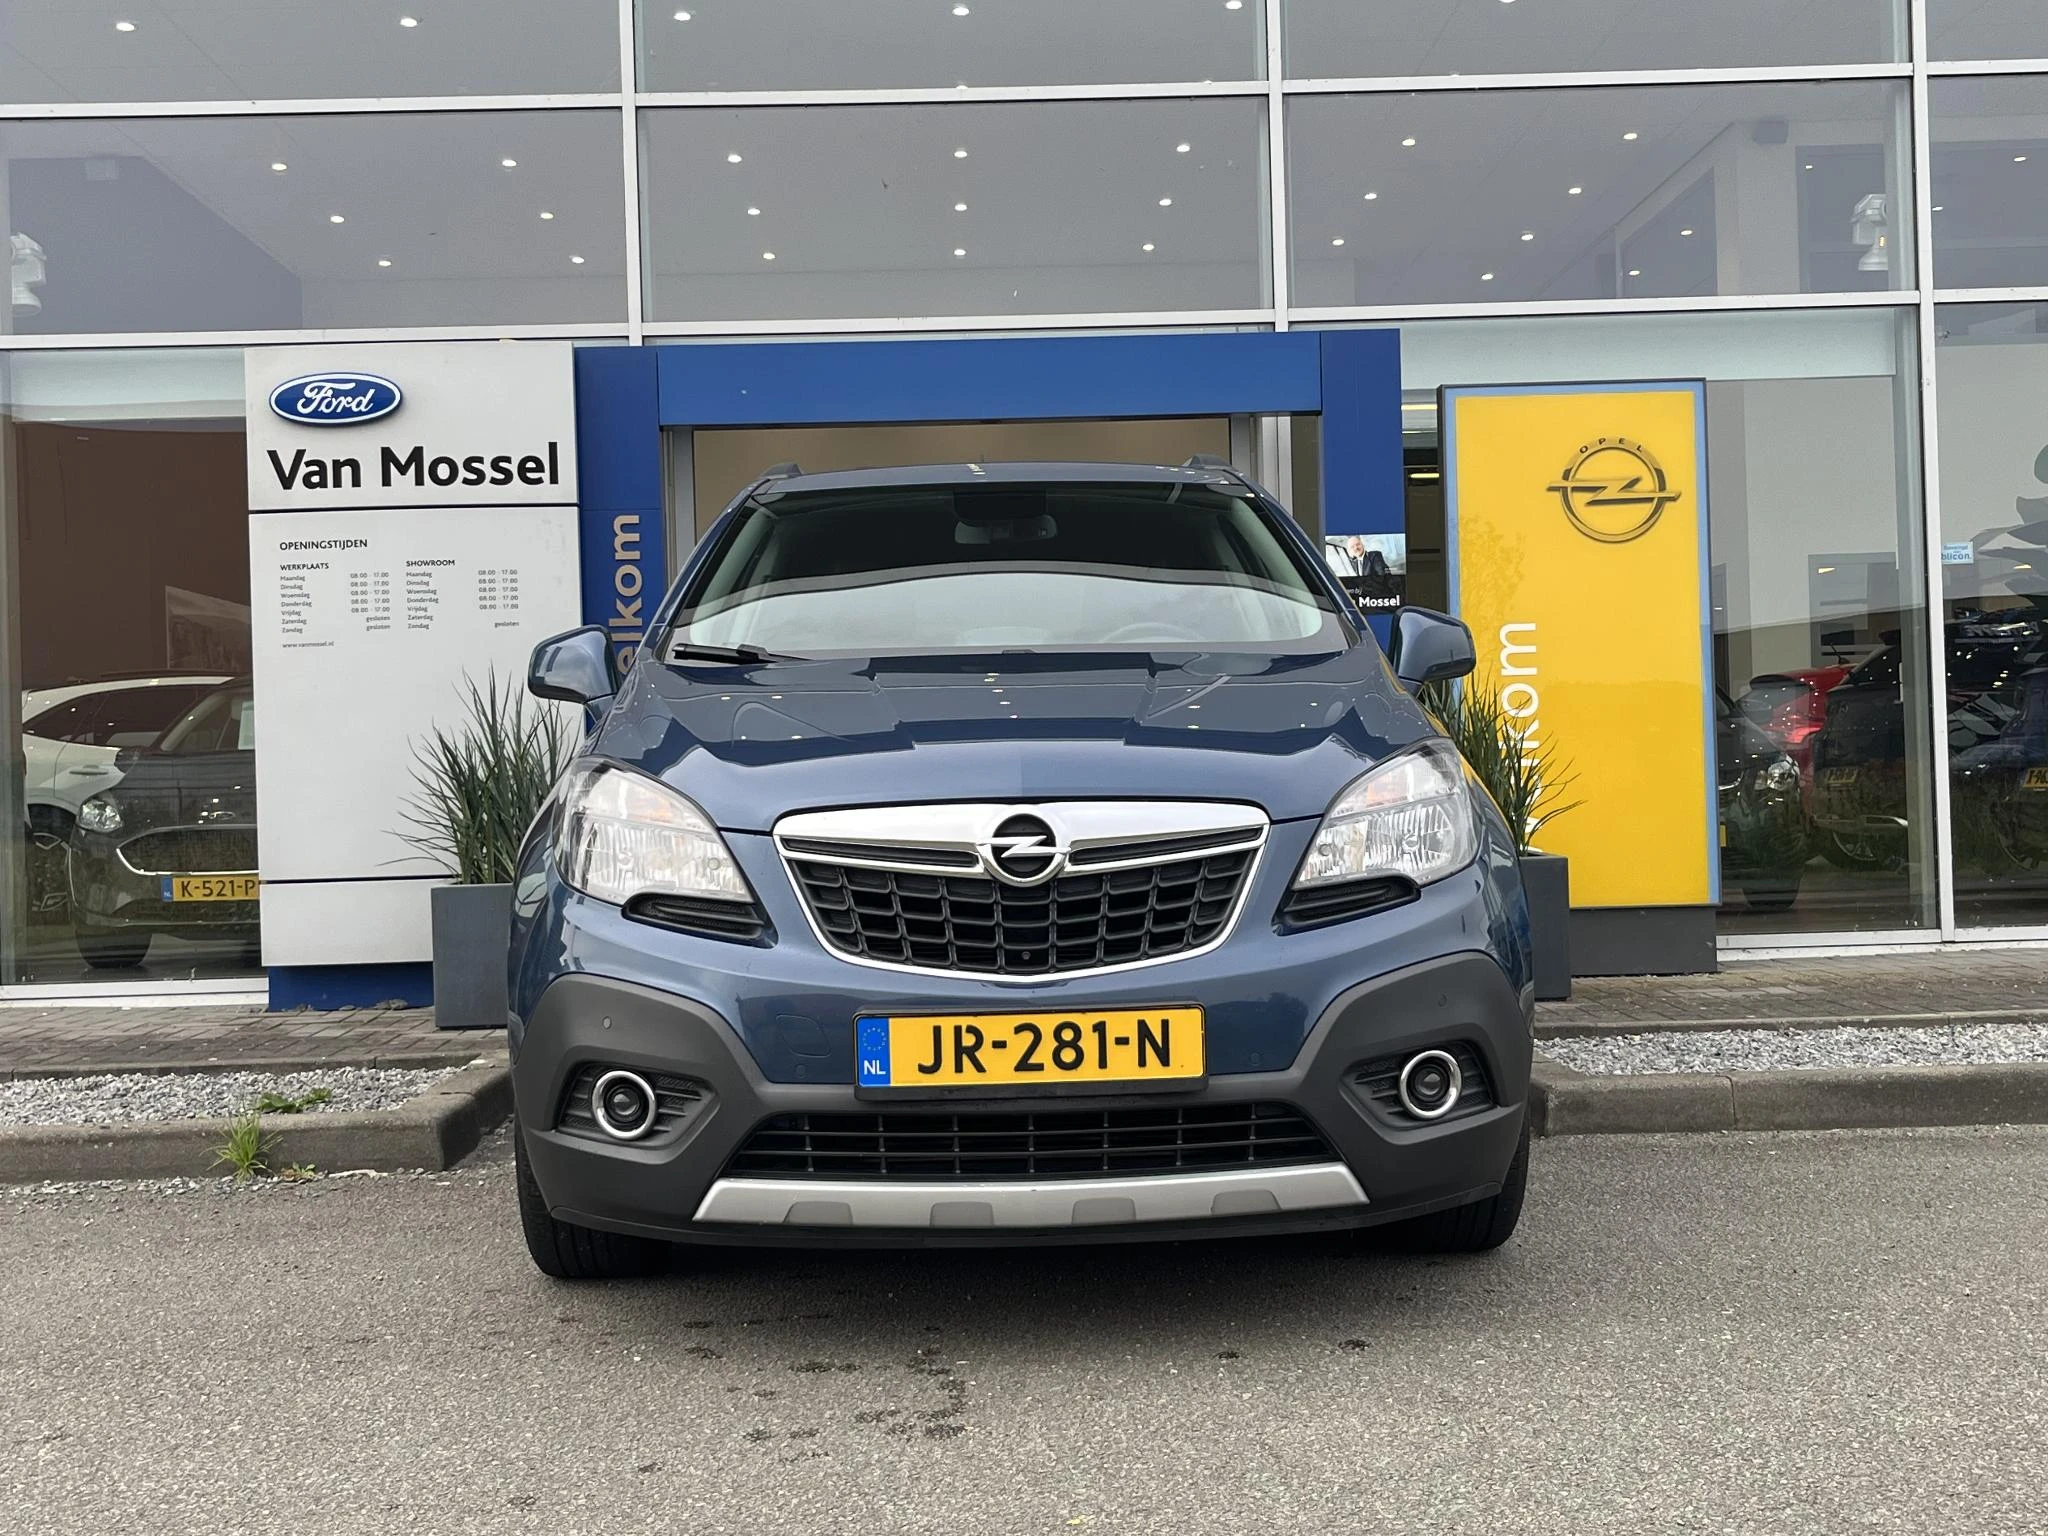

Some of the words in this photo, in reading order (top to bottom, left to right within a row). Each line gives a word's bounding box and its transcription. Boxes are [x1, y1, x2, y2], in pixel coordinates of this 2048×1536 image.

[296, 381, 375, 414] Ford
[1579, 437, 1643, 454] OPEL
[267, 448, 361, 490] Van
[380, 441, 559, 488] Mossel
[279, 538, 368, 551] OPENINGSTIJDEN
[280, 562, 329, 571] WERKPLAATS
[406, 559, 455, 567] SHOWROOM
[608, 514, 643, 675] elkom
[1359, 595, 1400, 607] Mossel
[917, 1018, 1171, 1074] JR-281-N
[863, 1059, 886, 1075] NL
